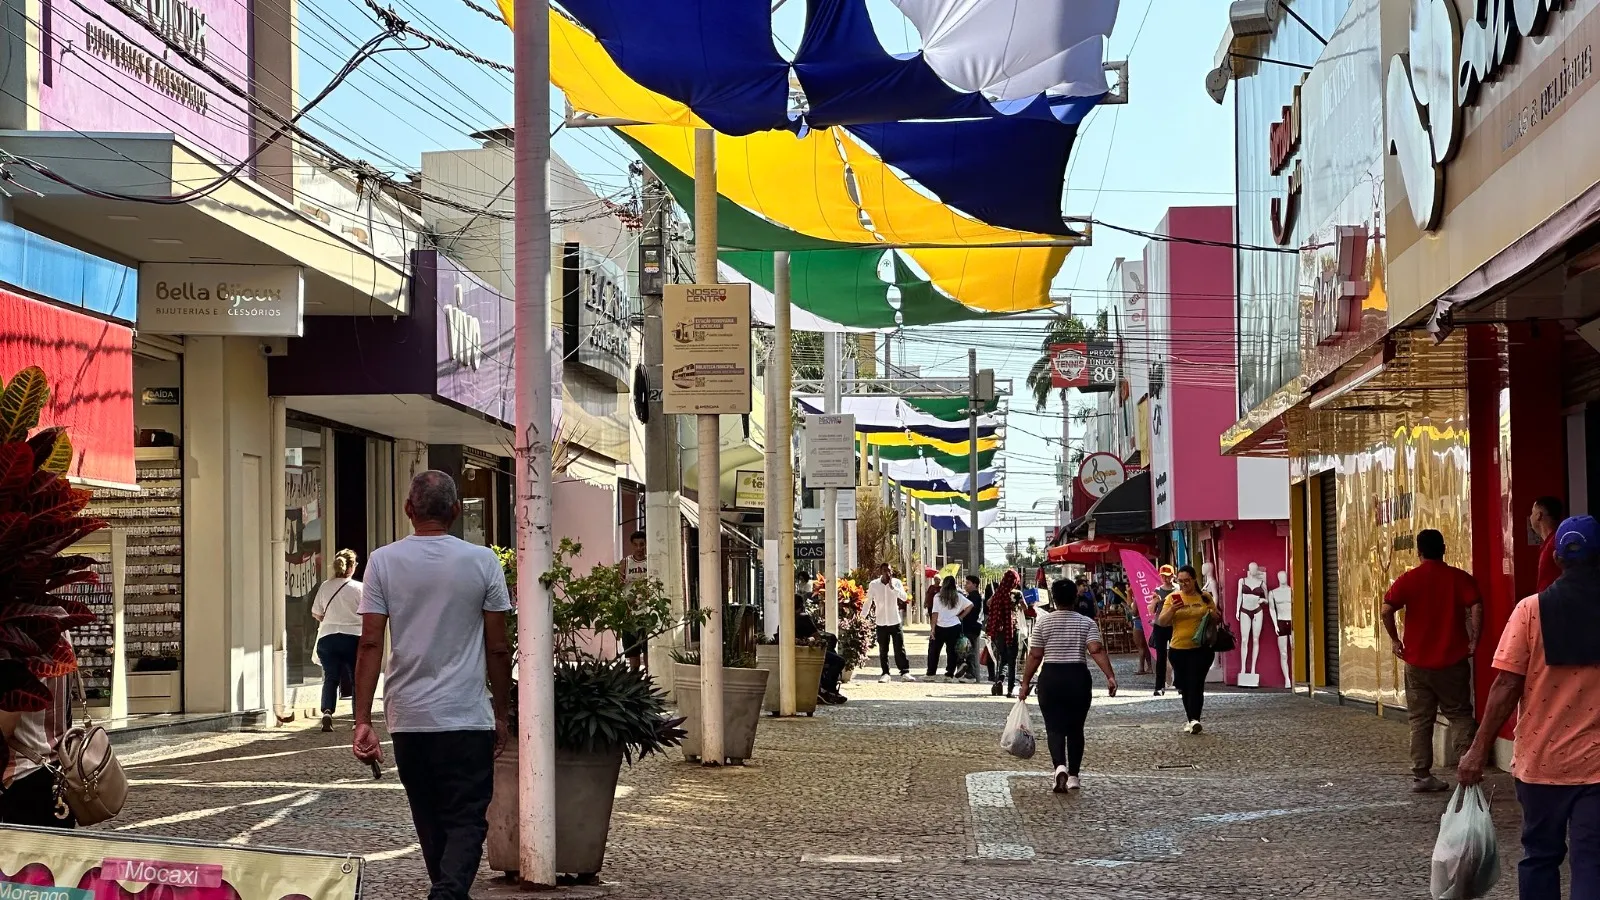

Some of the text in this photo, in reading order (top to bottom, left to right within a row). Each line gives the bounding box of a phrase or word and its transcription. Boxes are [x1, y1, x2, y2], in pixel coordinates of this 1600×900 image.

[156, 281, 281, 307] Bella Bijoux
[686, 288, 727, 296] NOSSO
[155, 307, 281, 317] BIJUTERIAS E CESSÓRIOS
[1093, 366, 1116, 382] 80
[124, 860, 199, 886] Mocaxi
[0, 882, 69, 900] Morango
